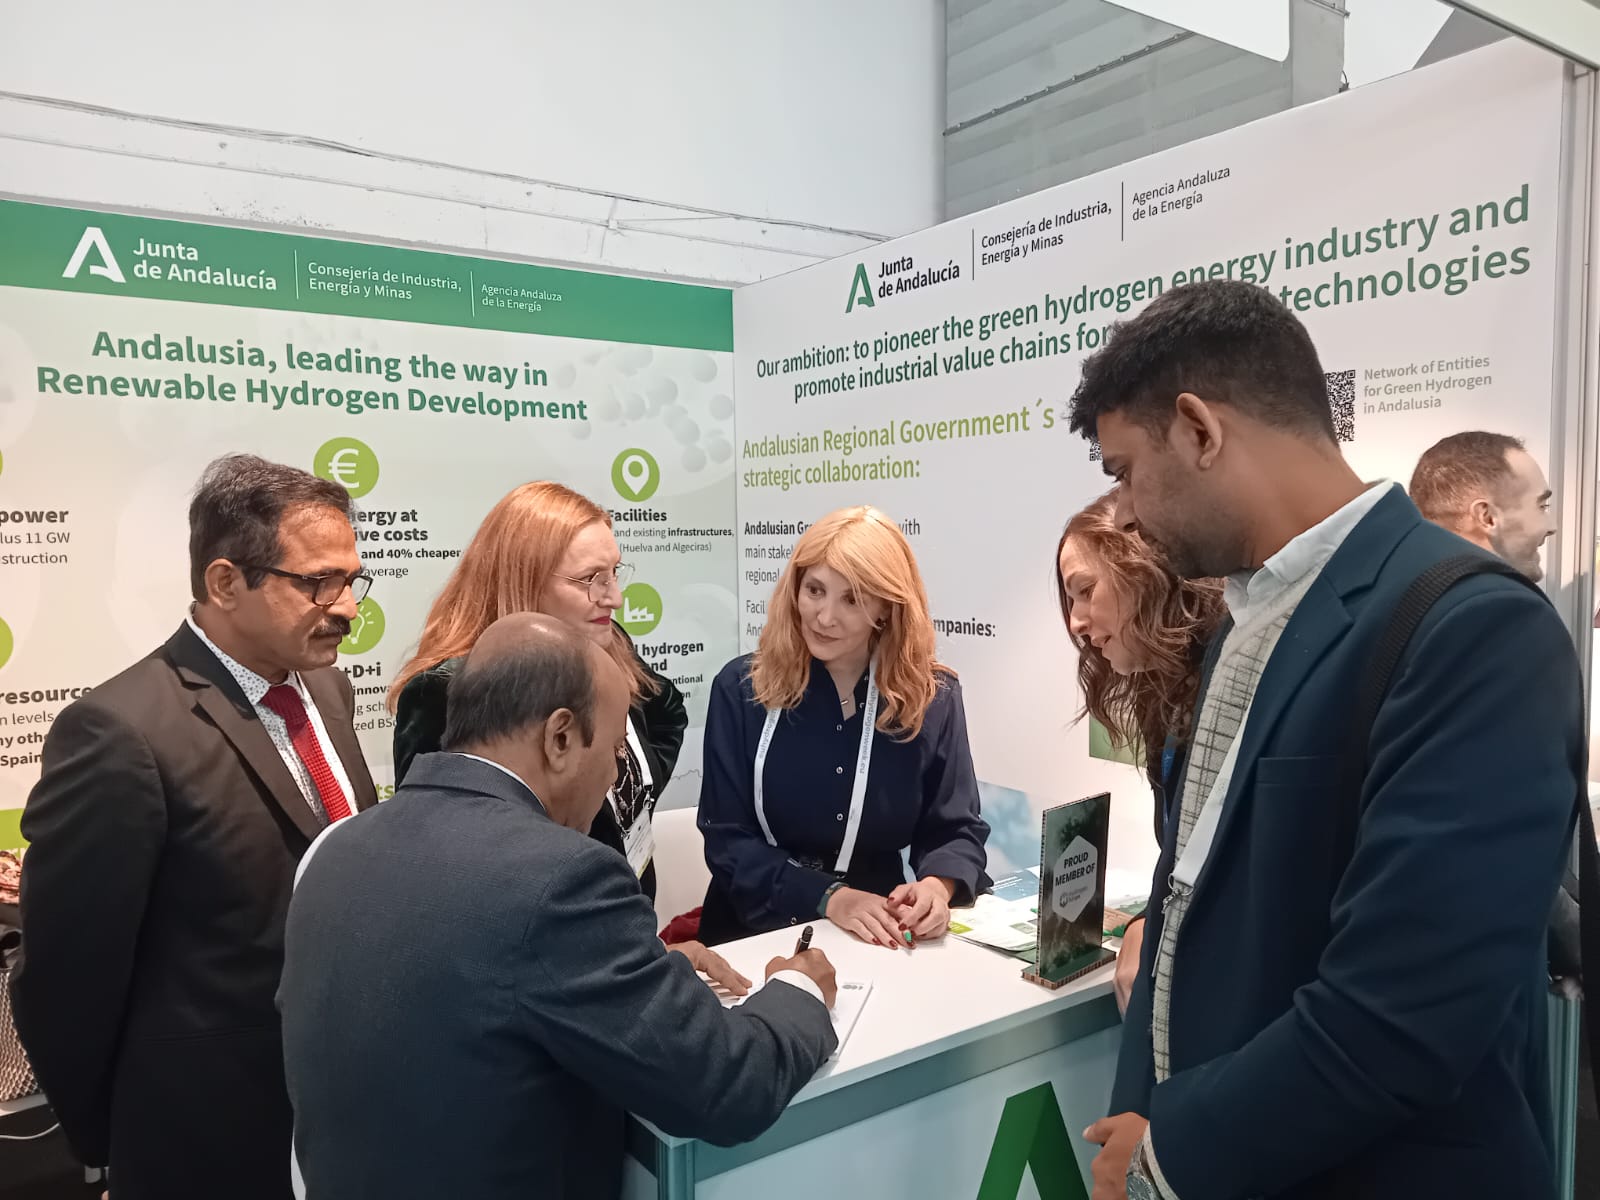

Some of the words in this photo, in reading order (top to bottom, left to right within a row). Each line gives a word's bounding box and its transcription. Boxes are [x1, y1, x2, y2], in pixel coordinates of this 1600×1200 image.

[1132, 183, 1174, 207] Agencia
[1177, 166, 1230, 191] Andaluza
[1133, 208, 1145, 222] de
[1148, 204, 1158, 218] la
[1160, 191, 1203, 216] Energía
[981, 220, 1036, 248] Consejería
[1039, 215, 1053, 233] de
[1055, 201, 1112, 228] Industria,
[133, 238, 199, 261] Junta
[982, 243, 1020, 266] Energía
[1022, 245, 1029, 258] y
[1031, 233, 1064, 253] Minas
[134, 260, 162, 280] de
[168, 265, 277, 290] Andalucía
[878, 255, 913, 279] Junta
[308, 262, 379, 283] Consejería
[382, 270, 399, 283] de
[402, 273, 462, 292] Industria,
[757, 359, 781, 378] Our
[782, 346, 850, 376] ambition:
[853, 342, 869, 360] to
[873, 326, 939, 363] pioneer
[943, 316, 973, 342] the
[978, 303, 1038, 341] green
[1045, 275, 1163, 323] hydrogen
[1172, 249, 1276, 287] energy
[1285, 213, 1439, 270] industry
[1449, 183, 1529, 236] and
[878, 281, 894, 299] de
[895, 260, 960, 296] Andalucía
[1279, 244, 1531, 312] technologies
[309, 278, 360, 297] Energía
[364, 285, 372, 297] y
[374, 284, 412, 300] Minas
[481, 284, 518, 298] Agencia
[520, 288, 562, 301] Andaluza
[482, 296, 494, 306] de
[496, 298, 505, 307] la
[507, 298, 542, 312] Energía
[92, 331, 277, 374] Andalusia,
[286, 343, 401, 382] leading
[409, 354, 456, 381] the
[463, 362, 518, 390] way
[524, 362, 547, 386] in
[794, 368, 856, 404] promote
[859, 354, 938, 389] industrial
[943, 345, 994, 375] value
[1000, 329, 1071, 363] chains
[1077, 323, 1112, 348] for
[1364, 365, 1418, 381] Network
[1421, 360, 1435, 374] of
[1437, 355, 1490, 372] Entities
[36, 366, 236, 402] Renewable
[246, 378, 400, 415] Hydrogen
[408, 388, 588, 422] Development
[1364, 383, 1381, 397] for
[1384, 379, 1422, 396] Green
[1425, 373, 1492, 393] Hydrogen
[1364, 401, 1376, 414] in
[1378, 396, 1442, 413] Andalusia
[743, 431, 819, 459] Andalusian
[823, 421, 895, 454] Regional
[900, 405, 1030, 444] Government
[743, 464, 802, 491] strategic
[805, 455, 921, 483] collaboration:
[0, 510, 69, 527] power
[401, 509, 418, 522] at
[607, 509, 668, 522] Facilities
[353, 527, 380, 541] ive
[384, 529, 428, 541] costs
[614, 528, 631, 537] and
[633, 527, 667, 539] existing
[668, 527, 735, 538] infrastructures,
[745, 520, 796, 535] Andalusian
[0, 531, 22, 544] lus
[26, 532, 43, 544] 11
[46, 531, 70, 544] GW
[361, 548, 384, 559] and
[386, 549, 413, 559] 40%
[415, 548, 461, 561] cheaper
[619, 543, 653, 554] (Huelva
[654, 543, 671, 552] and
[672, 542, 712, 554] Algeciras)
[745, 545, 767, 559] main
[1, 552, 68, 565] struction
[364, 566, 409, 579] average
[745, 567, 780, 585] regional
[746, 600, 766, 614] Facil
[933, 617, 996, 638] mpanies:
[642, 642, 704, 658] hydrogen
[672, 673, 703, 685] ntional
[12, 710, 55, 725] levels
[17, 731, 48, 745] oth
[1064, 852, 1089, 868] PROUD
[1055, 867, 1085, 887] MEMBER
[1086, 862, 1096, 875] OF
